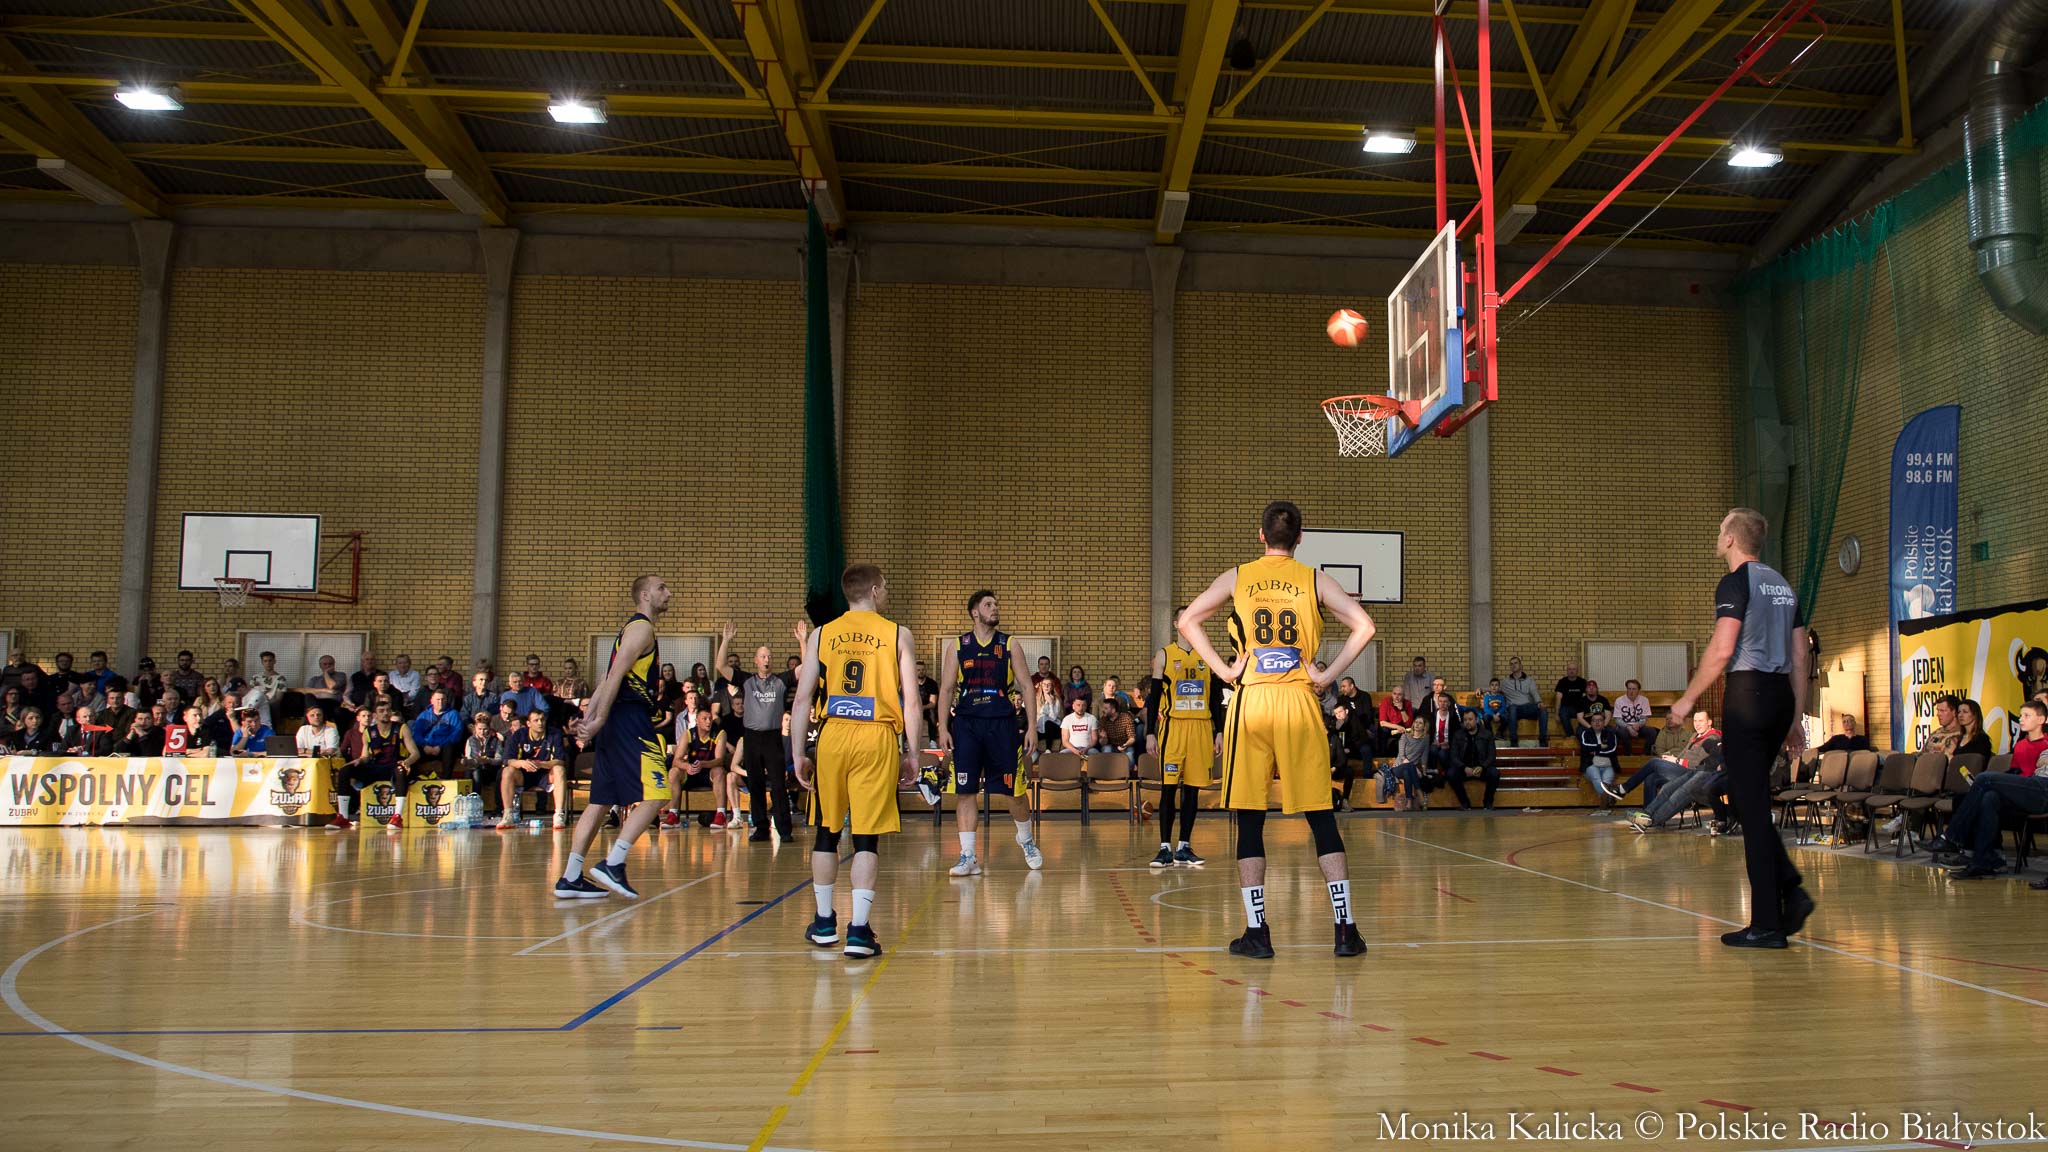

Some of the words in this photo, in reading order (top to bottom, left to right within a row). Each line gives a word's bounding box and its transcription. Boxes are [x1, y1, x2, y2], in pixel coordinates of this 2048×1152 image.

[1906, 453, 1933, 467] 99,4
[1937, 453, 1953, 466] FM
[1905, 470, 1932, 484] 98,6
[1936, 470, 1952, 483] FM
[1904, 525, 1919, 580] Polskie
[1921, 525, 1936, 580] Radio
[1936, 528, 1956, 616] iałystok
[1252, 607, 1299, 646] 88
[842, 658, 866, 696] 9
[1185, 668, 1197, 680] 18
[1912, 656, 1945, 685] JEDEN
[836, 706, 872, 717] Enea
[168, 728, 187, 750] 5
[11, 767, 157, 806] WSPÓLNY
[165, 774, 216, 806] CEL
[8, 808, 39, 817] ZUBRY
[367, 804, 396, 816] ZUBR
